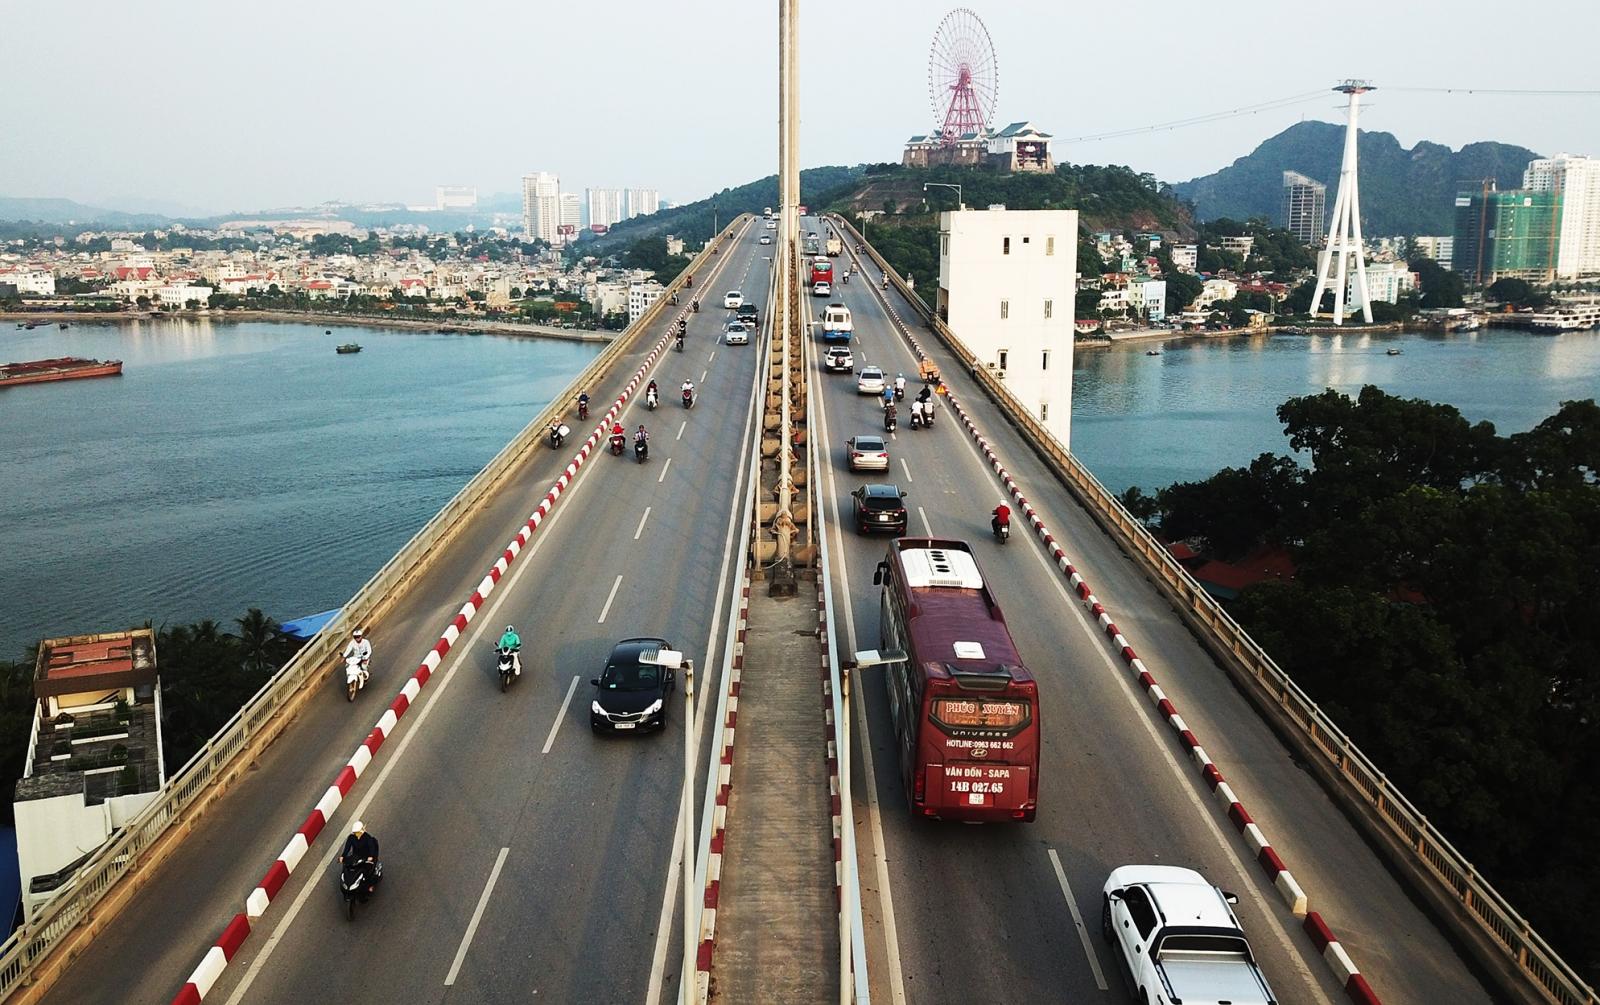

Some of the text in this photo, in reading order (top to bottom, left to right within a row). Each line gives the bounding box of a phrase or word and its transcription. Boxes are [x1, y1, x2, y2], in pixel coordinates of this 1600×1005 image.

[982, 702, 1019, 715] XUYÊN
[988, 769, 1010, 778] SAPA
[950, 781, 1003, 793] 14B 027.65
